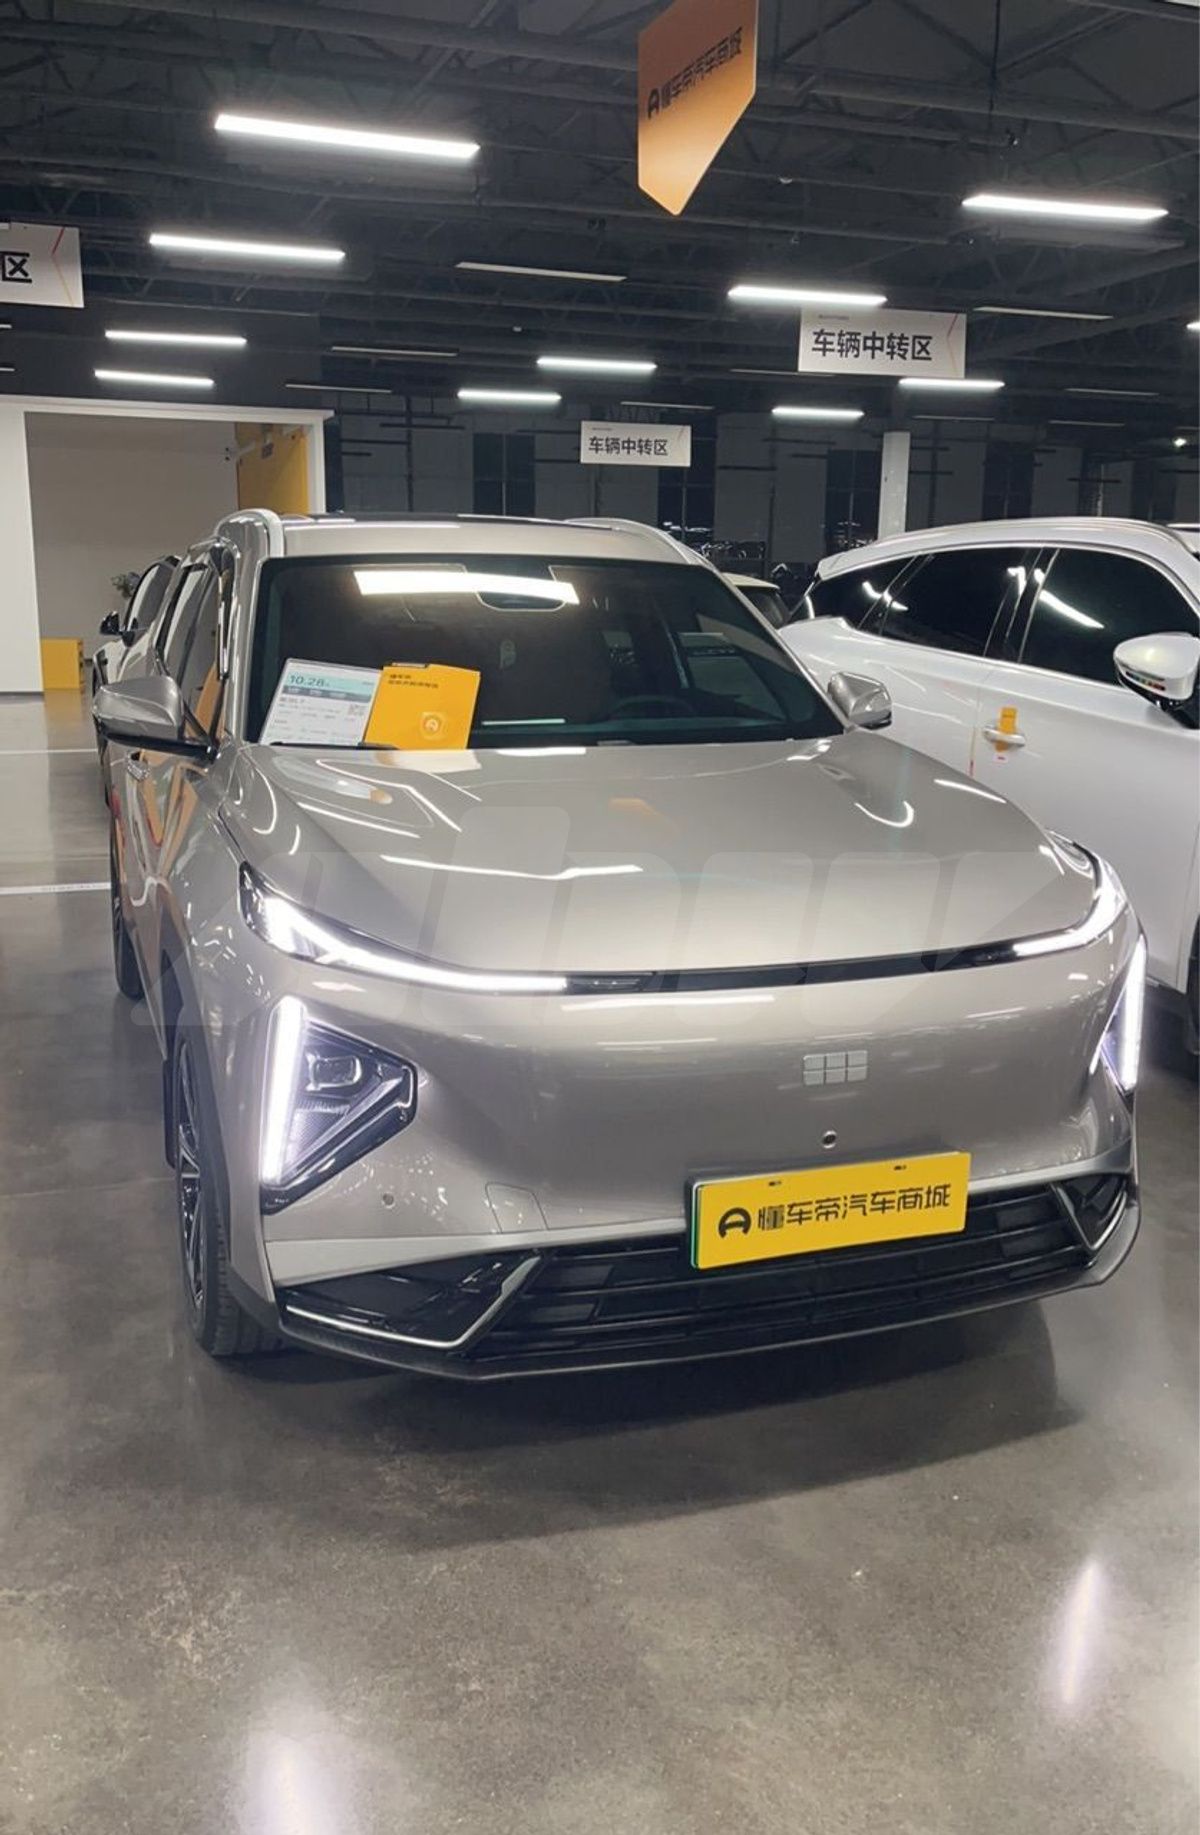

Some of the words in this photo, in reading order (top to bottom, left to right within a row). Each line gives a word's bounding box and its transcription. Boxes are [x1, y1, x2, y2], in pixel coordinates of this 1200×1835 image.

[0, 250, 32, 283] 区
[811, 328, 933, 361] 车辆中转区
[588, 436, 668, 456] 车辆中转区
[757, 1184, 952, 1231] 懂车帝汽车商城
